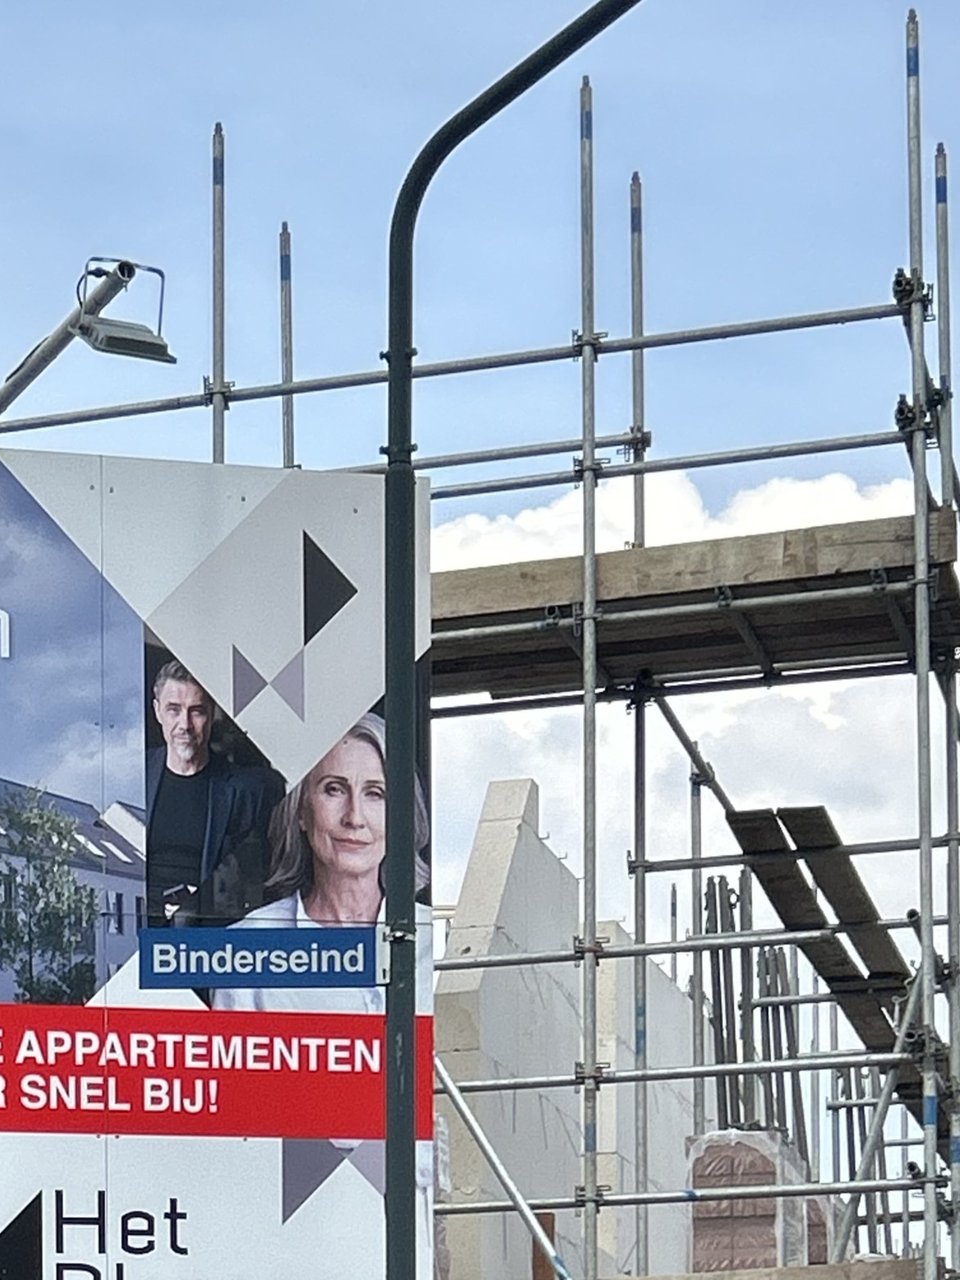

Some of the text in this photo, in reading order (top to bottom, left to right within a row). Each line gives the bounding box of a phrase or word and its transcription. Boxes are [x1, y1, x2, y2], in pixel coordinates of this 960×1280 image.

[152, 943, 365, 975] Binderseind
[16, 1030, 381, 1073] APPARTEMENTEN
[19, 1074, 130, 1112] SNEL
[143, 1078, 219, 1114] BIJ!
[54, 1190, 188, 1256] Het
